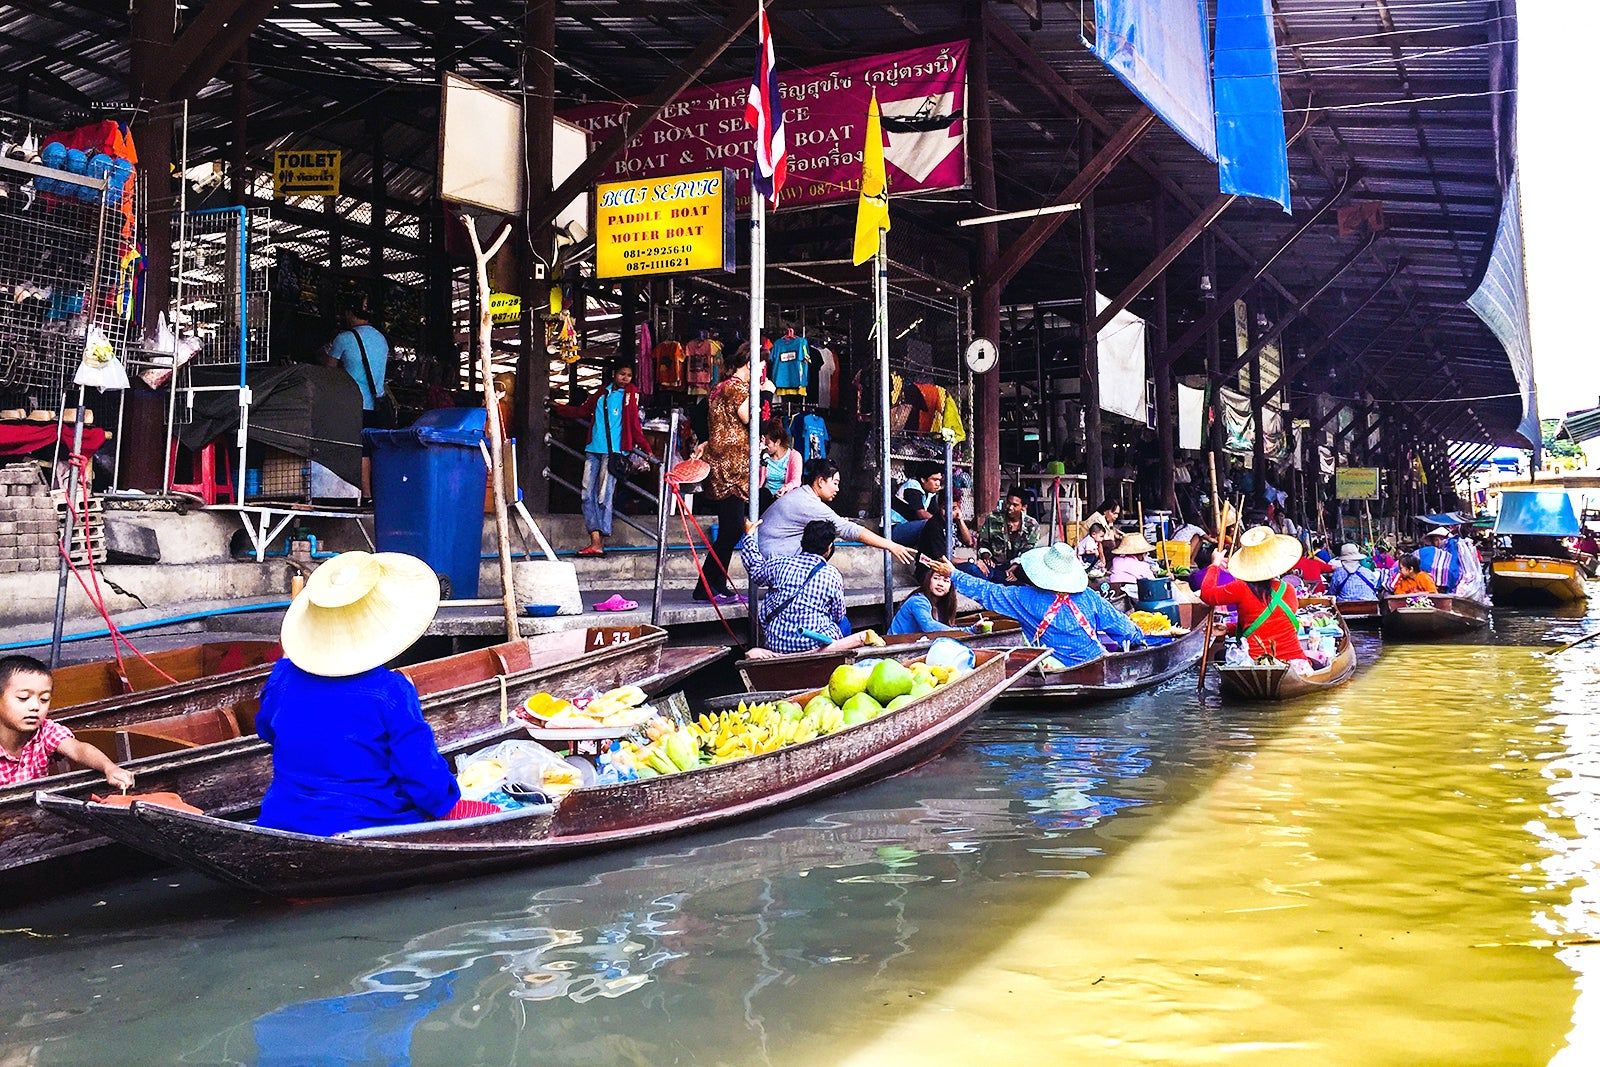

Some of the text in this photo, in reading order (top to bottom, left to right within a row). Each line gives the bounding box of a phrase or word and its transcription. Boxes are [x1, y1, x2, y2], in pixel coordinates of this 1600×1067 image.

[653, 122, 709, 145] BOAT
[614, 153, 669, 175] BOAT
[679, 149, 694, 164] &
[794, 124, 855, 148] BOAT
[278, 153, 337, 168] TOILET
[599, 187, 648, 208] BOAT
[608, 205, 710, 226] PADDLE BOAT
[611, 225, 704, 244] MOTER BOAT
[593, 631, 631, 647] A 33
